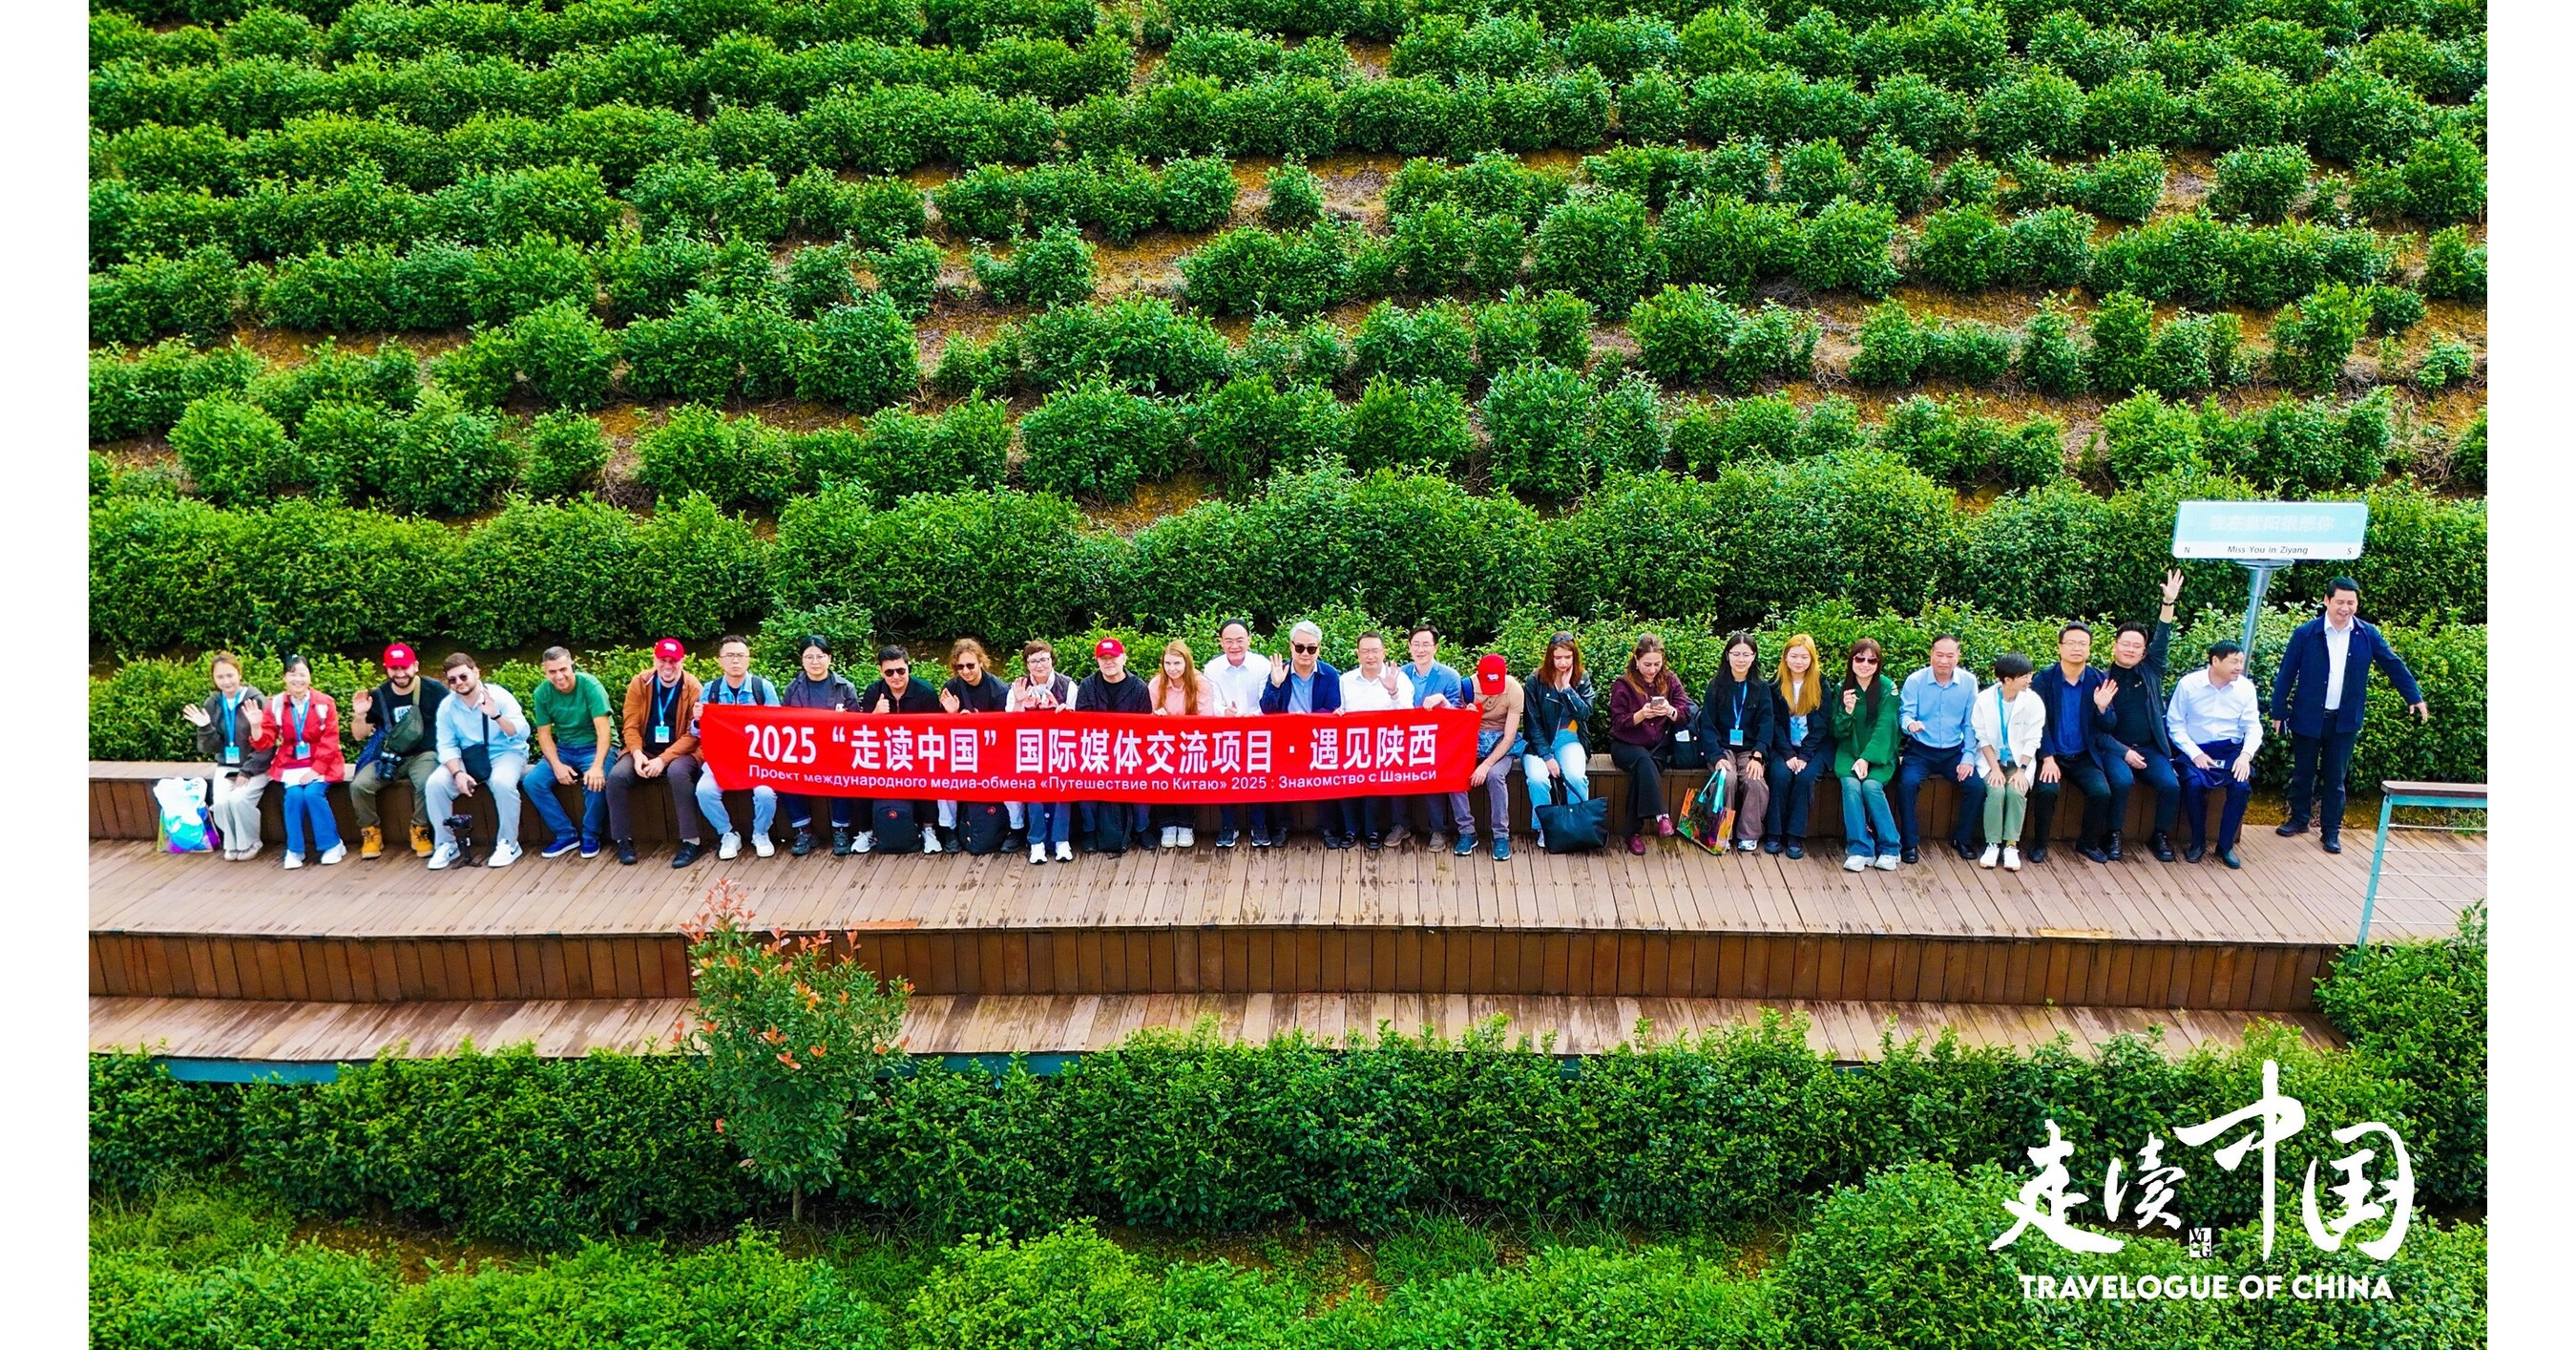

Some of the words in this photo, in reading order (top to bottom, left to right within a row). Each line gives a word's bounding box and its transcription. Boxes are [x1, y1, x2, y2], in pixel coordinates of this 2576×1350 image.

[2227, 545, 2246, 554] Miss
[2249, 545, 2266, 554] You
[2268, 545, 2277, 554] in
[2279, 545, 2309, 556] Ziyang
[2347, 547, 2353, 556] S
[748, 765, 800, 782] Проект
[804, 773, 927, 790] международного
[931, 776, 1037, 791] медиа-обмена
[1040, 776, 1148, 791] «Путешествие
[1151, 779, 1169, 791] по
[1173, 777, 1227, 791] Китаю»
[1231, 776, 1267, 791] 2025
[1278, 772, 1365, 790] Знакомство
[1368, 773, 1377, 783] с
[1380, 770, 1436, 783] Шэньси
